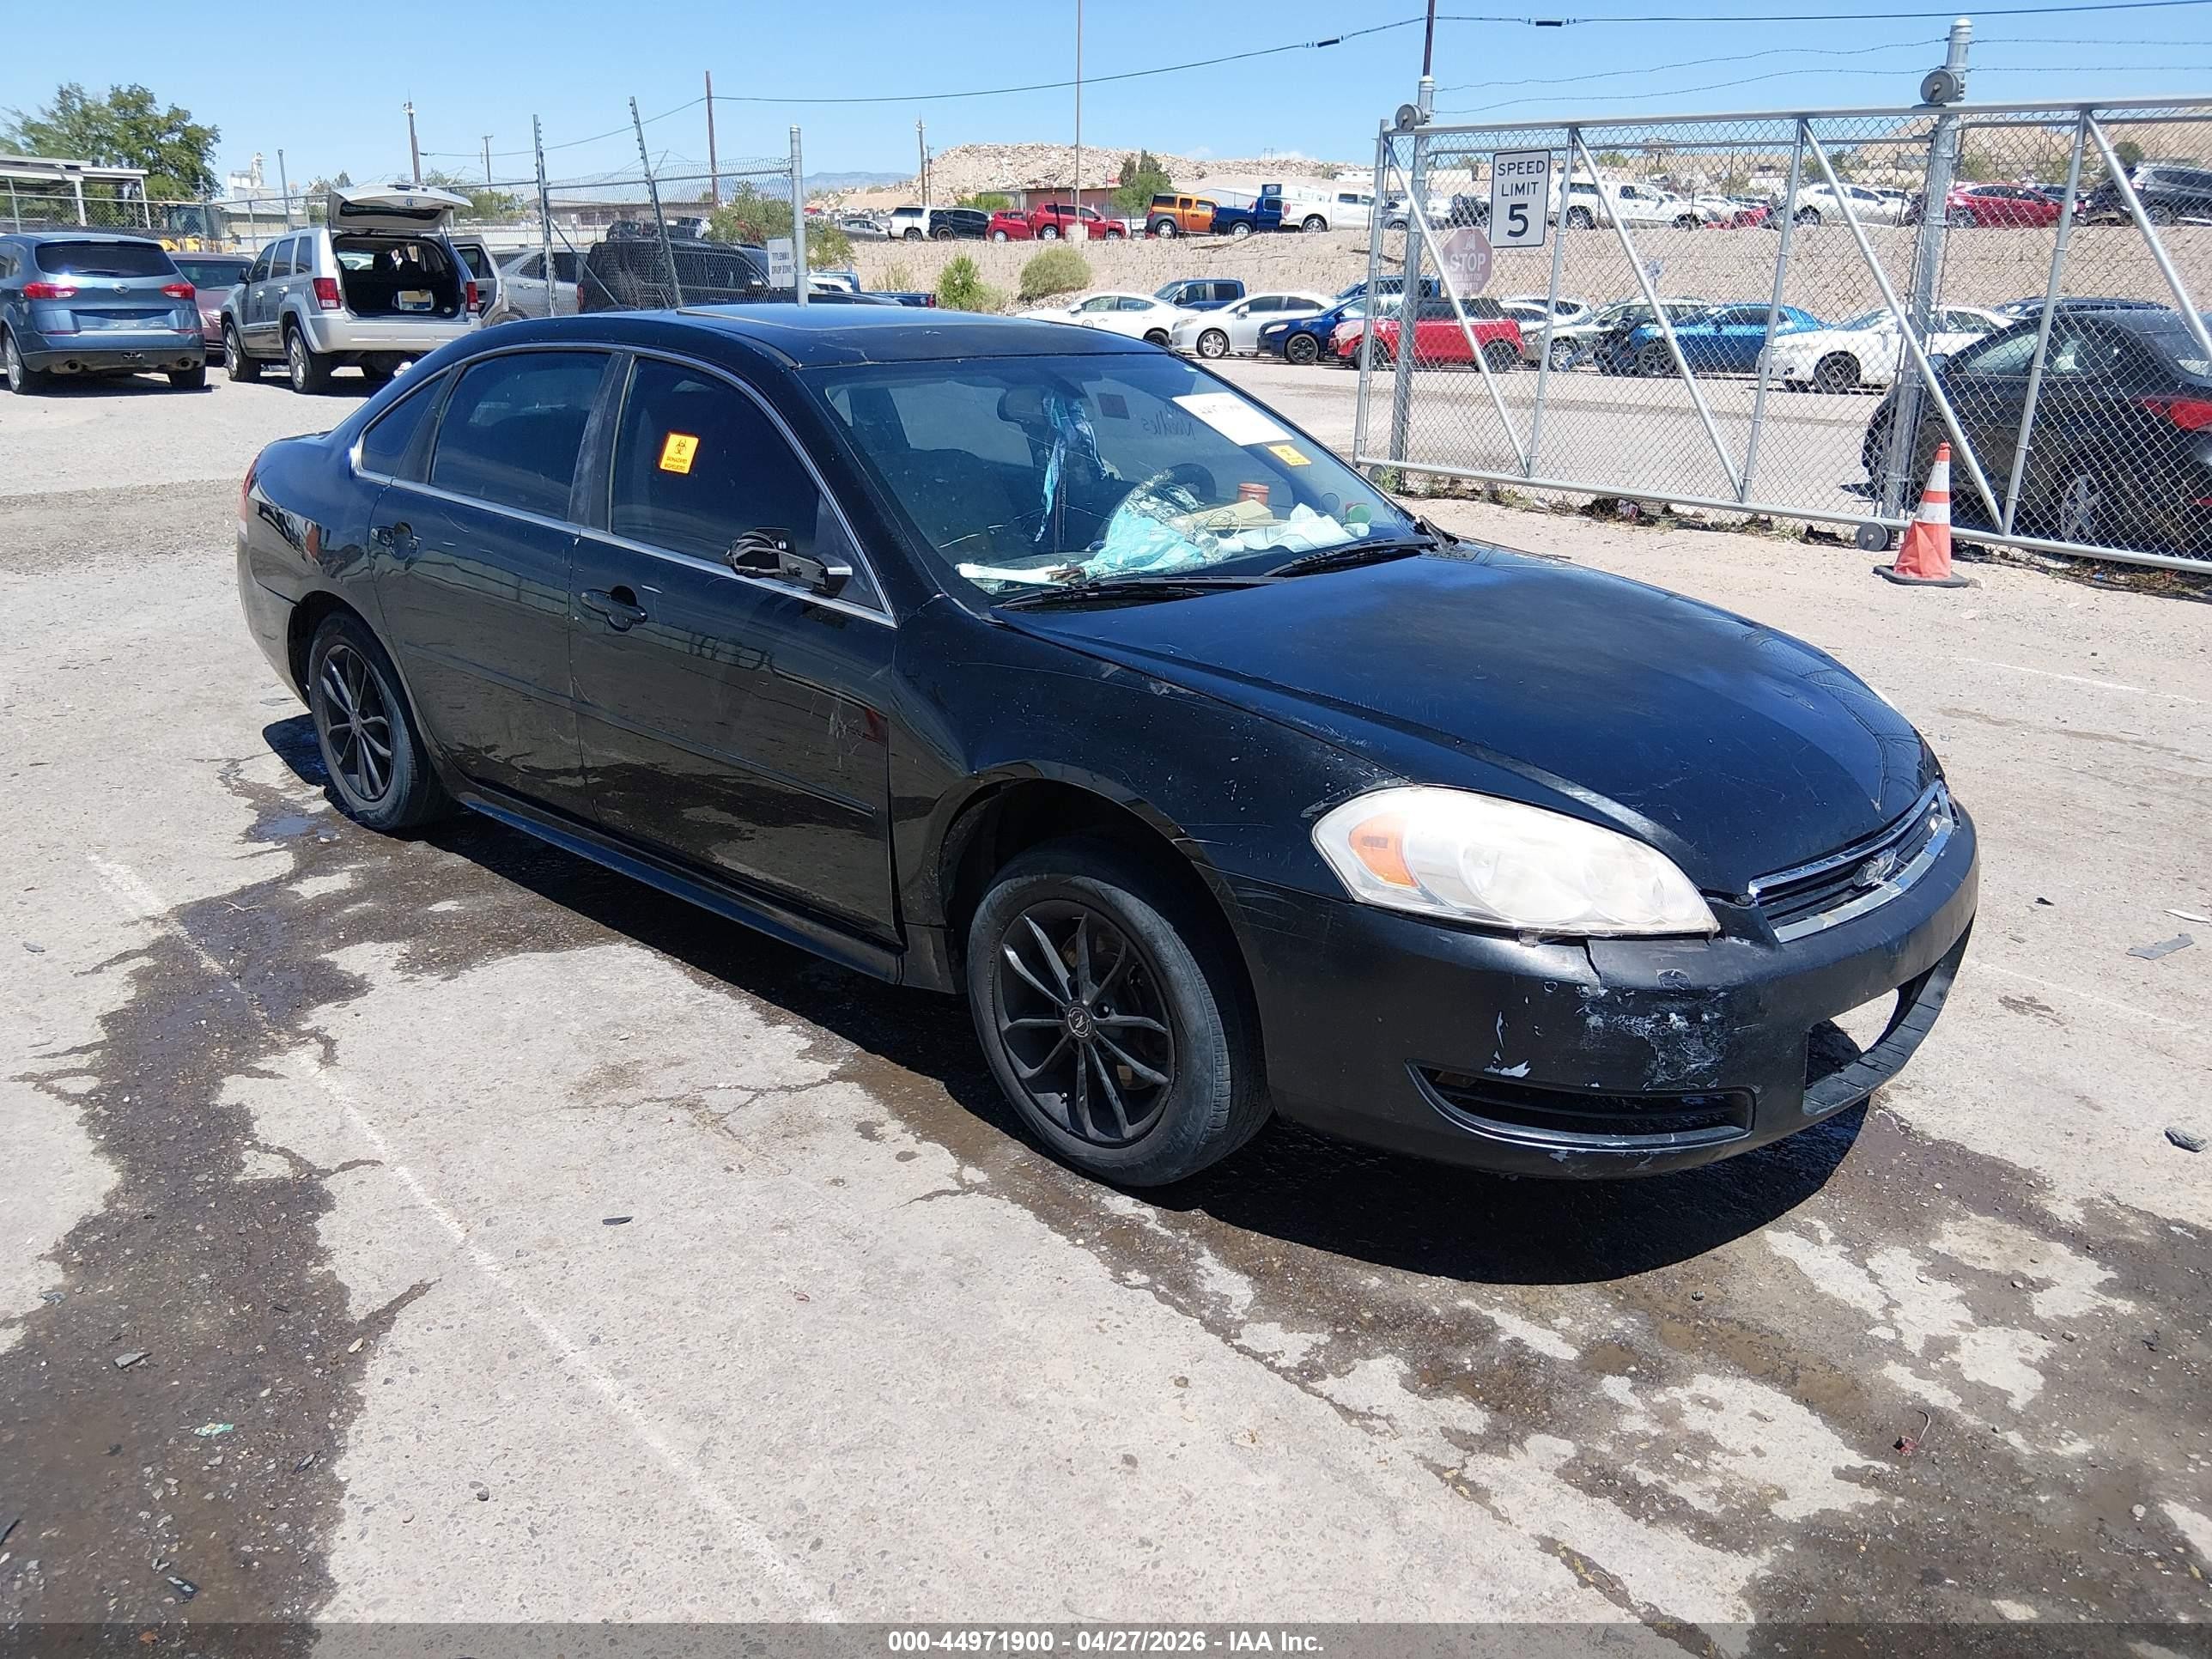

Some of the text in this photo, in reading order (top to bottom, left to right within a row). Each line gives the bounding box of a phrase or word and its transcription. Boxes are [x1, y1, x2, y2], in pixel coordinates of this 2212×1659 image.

[1498, 160, 1546, 177] SPEED
[1501, 181, 1540, 197] LIMIT
[1507, 203, 1529, 238] 5
[1449, 252, 1486, 272] STOP
